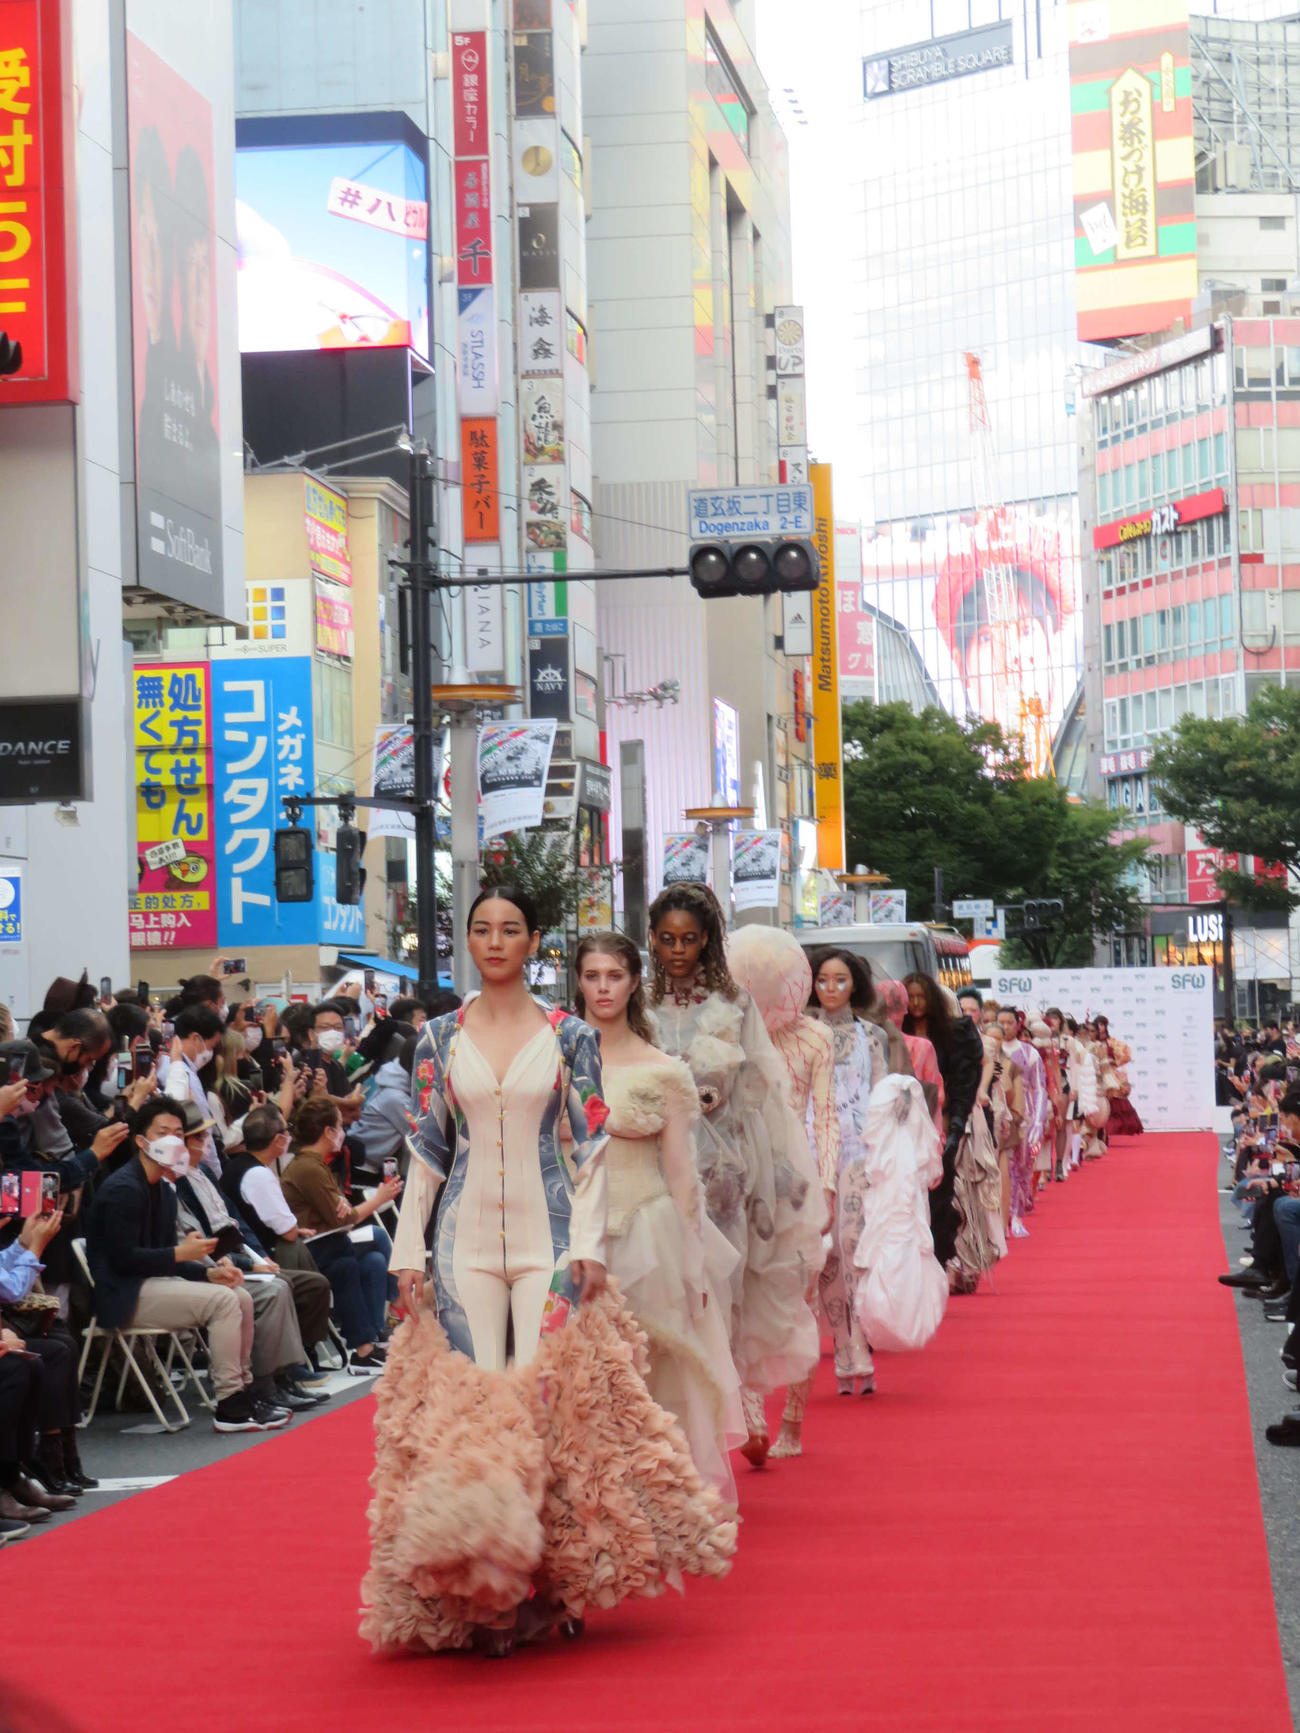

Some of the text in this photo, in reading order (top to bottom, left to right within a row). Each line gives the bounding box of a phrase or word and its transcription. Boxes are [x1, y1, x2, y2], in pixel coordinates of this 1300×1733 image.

[694, 492, 808, 518] 道玄坂二丁目東
[699, 518, 769, 535] Dogenzaka
[166, 518, 212, 574] SoftBank
[536, 682, 563, 690] NAVY
[168, 673, 203, 835] 処方せん
[223, 680, 271, 924] コンタクト
[998, 976, 1032, 994] SFW
[1171, 973, 1205, 990] SFW
